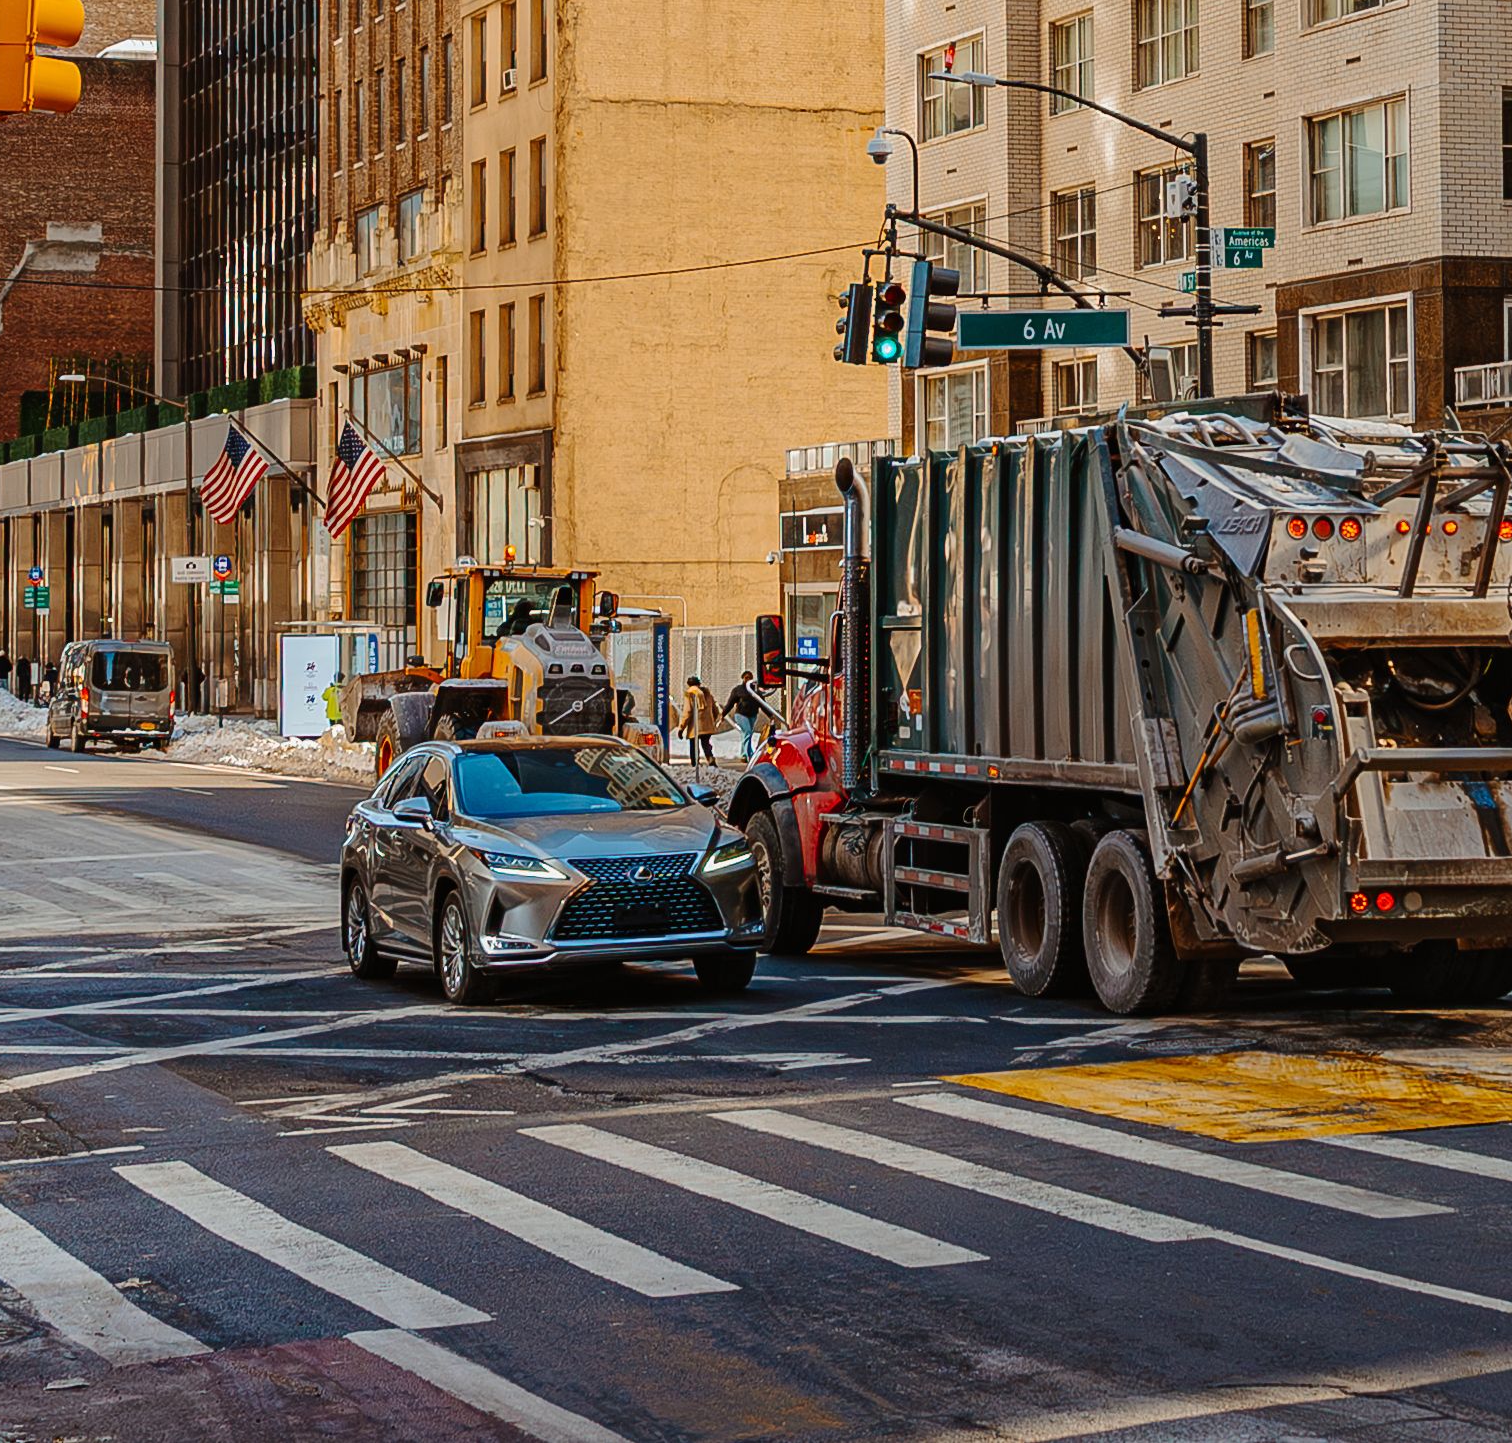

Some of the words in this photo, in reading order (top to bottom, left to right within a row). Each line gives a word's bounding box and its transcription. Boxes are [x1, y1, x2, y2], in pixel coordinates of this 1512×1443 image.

[1229, 236, 1269, 247] Americas
[1233, 251, 1241, 266] 6
[1245, 250, 1254, 259] Av
[1023, 319, 1035, 339] 6
[1044, 318, 1066, 340] Av
[1218, 515, 1266, 535] LEACH
